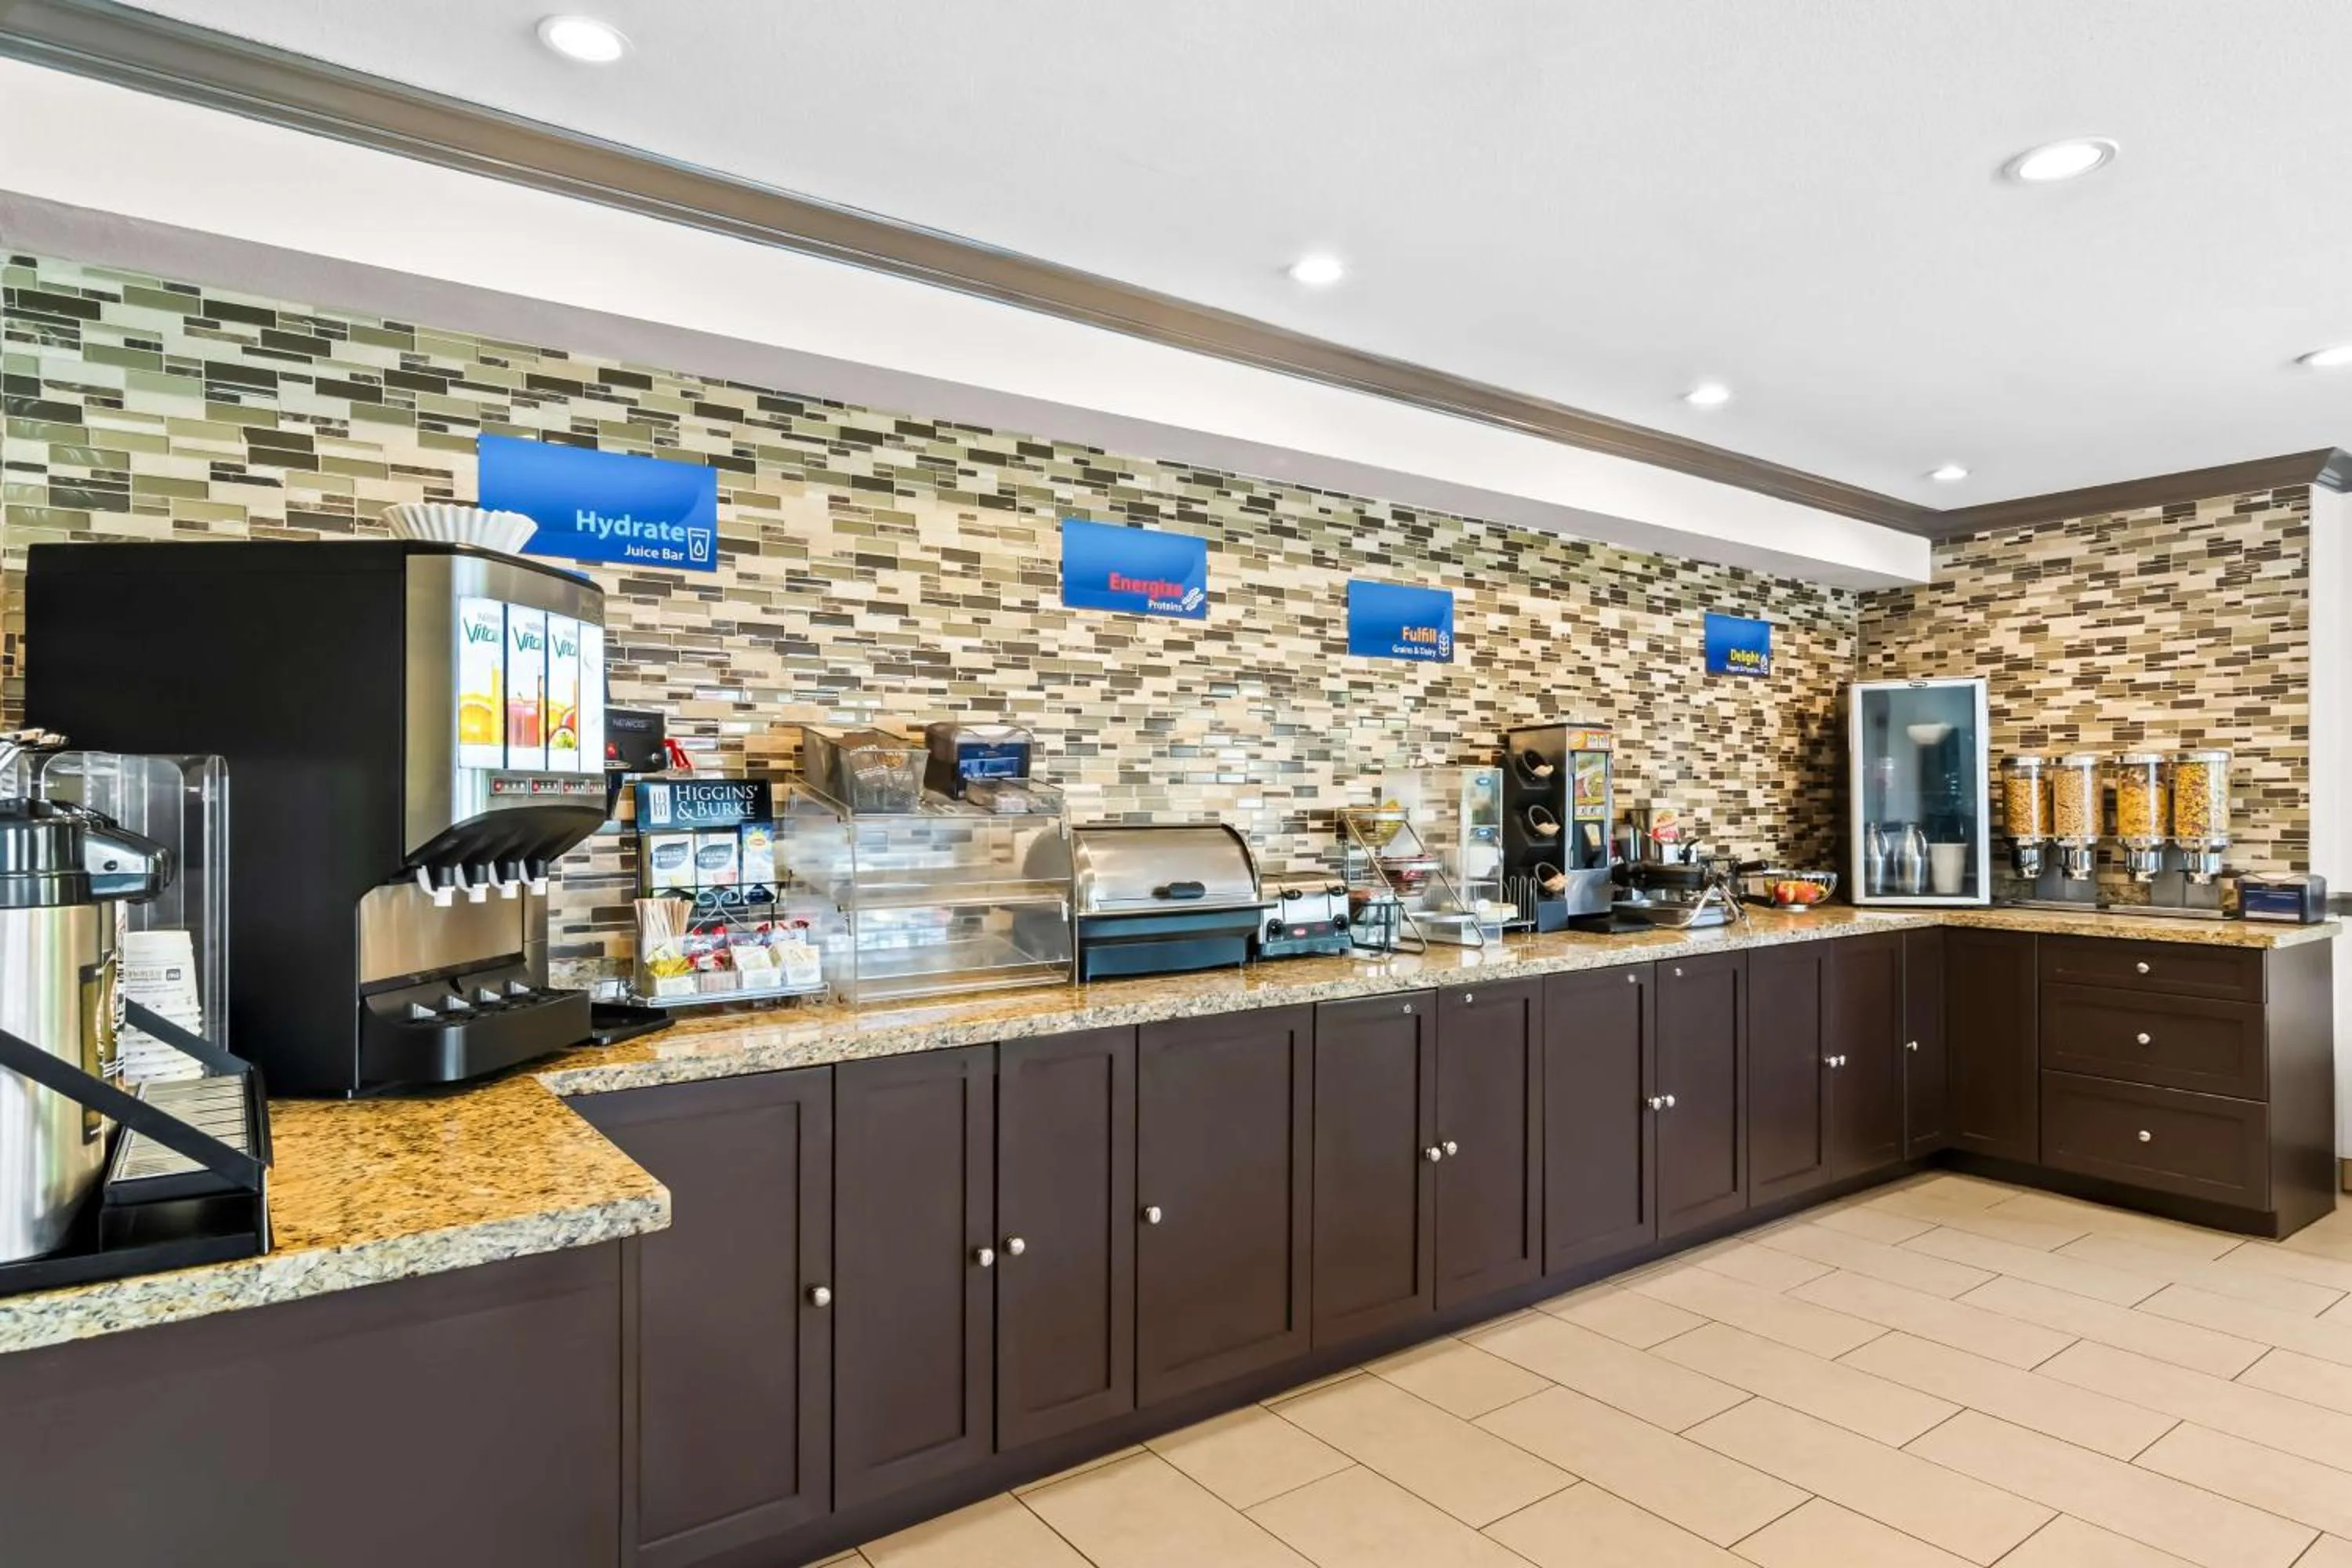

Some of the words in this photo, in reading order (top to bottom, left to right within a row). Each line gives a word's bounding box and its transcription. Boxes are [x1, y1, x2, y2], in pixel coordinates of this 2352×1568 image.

[576, 510, 685, 542] Hydrate
[624, 544, 659, 558] Juice
[662, 548, 684, 561] Bar
[1109, 572, 1183, 599] Energize
[1148, 600, 1182, 612] Proteins
[1402, 626, 1437, 643] Fulfill
[1392, 644, 1413, 655] Grains
[1420, 647, 1436, 657] Dairy
[1730, 648, 1760, 665] Delight
[677, 801, 692, 820] &
[696, 801, 755, 816] BURKE
